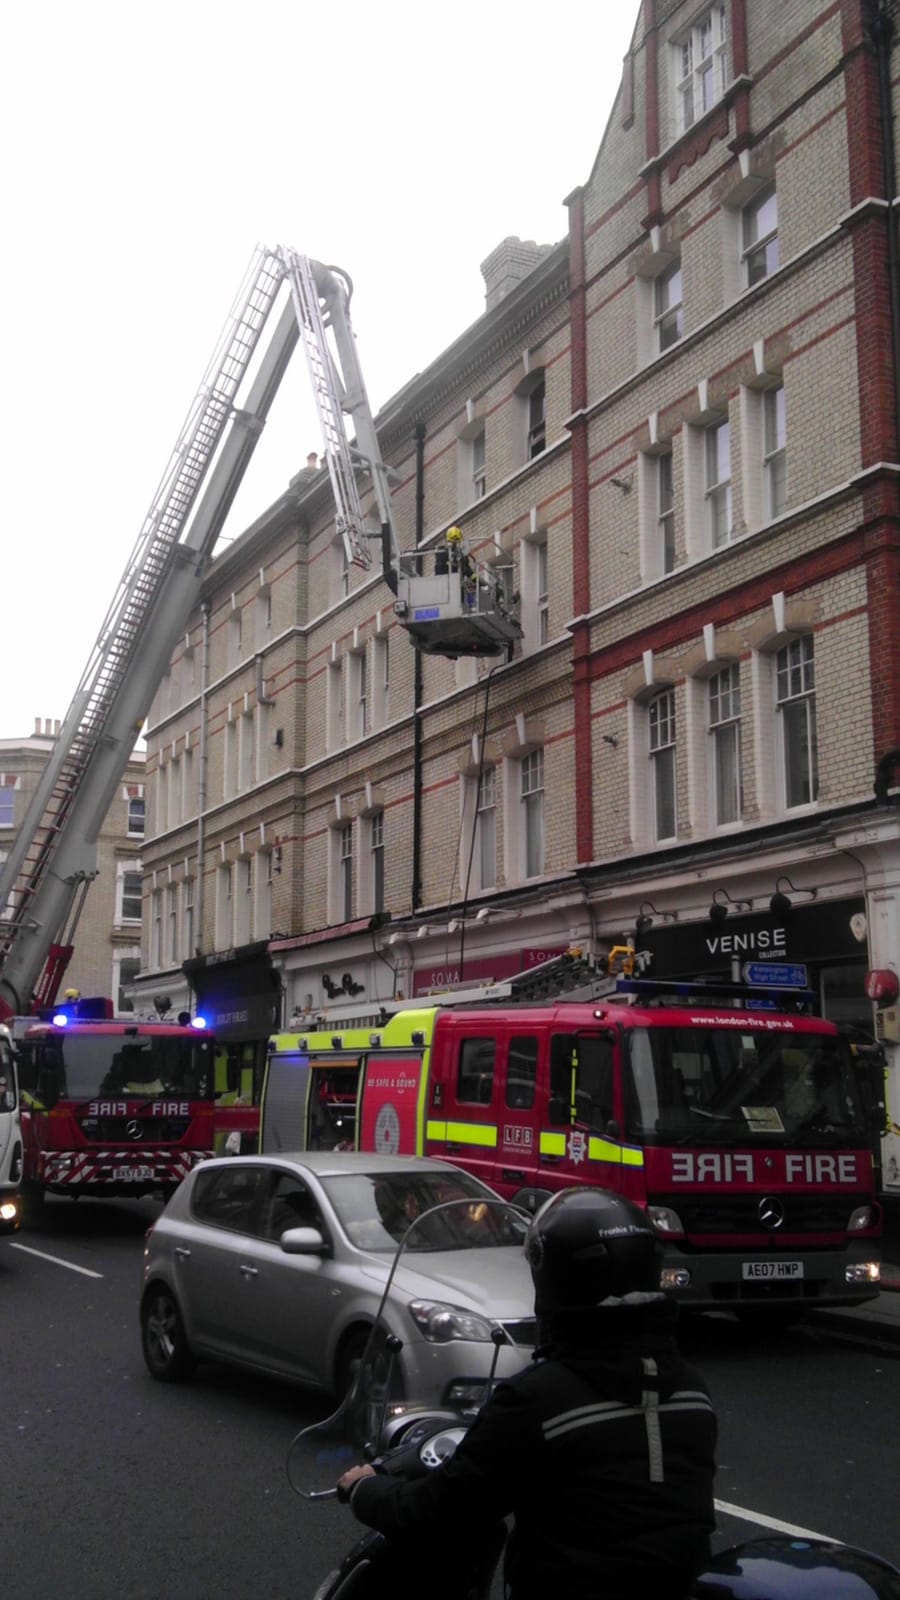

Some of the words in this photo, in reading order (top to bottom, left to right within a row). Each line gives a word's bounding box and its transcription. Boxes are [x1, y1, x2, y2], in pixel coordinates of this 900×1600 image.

[706, 928, 786, 954] VENISE
[690, 1016, 794, 1029] www.london-fire.gov.uk
[152, 1102, 189, 1115] FIRE
[505, 1127, 531, 1144] LFB
[785, 1154, 857, 1183] FIRE
[747, 1263, 775, 1277] AE07
[777, 1263, 799, 1276] HWP
